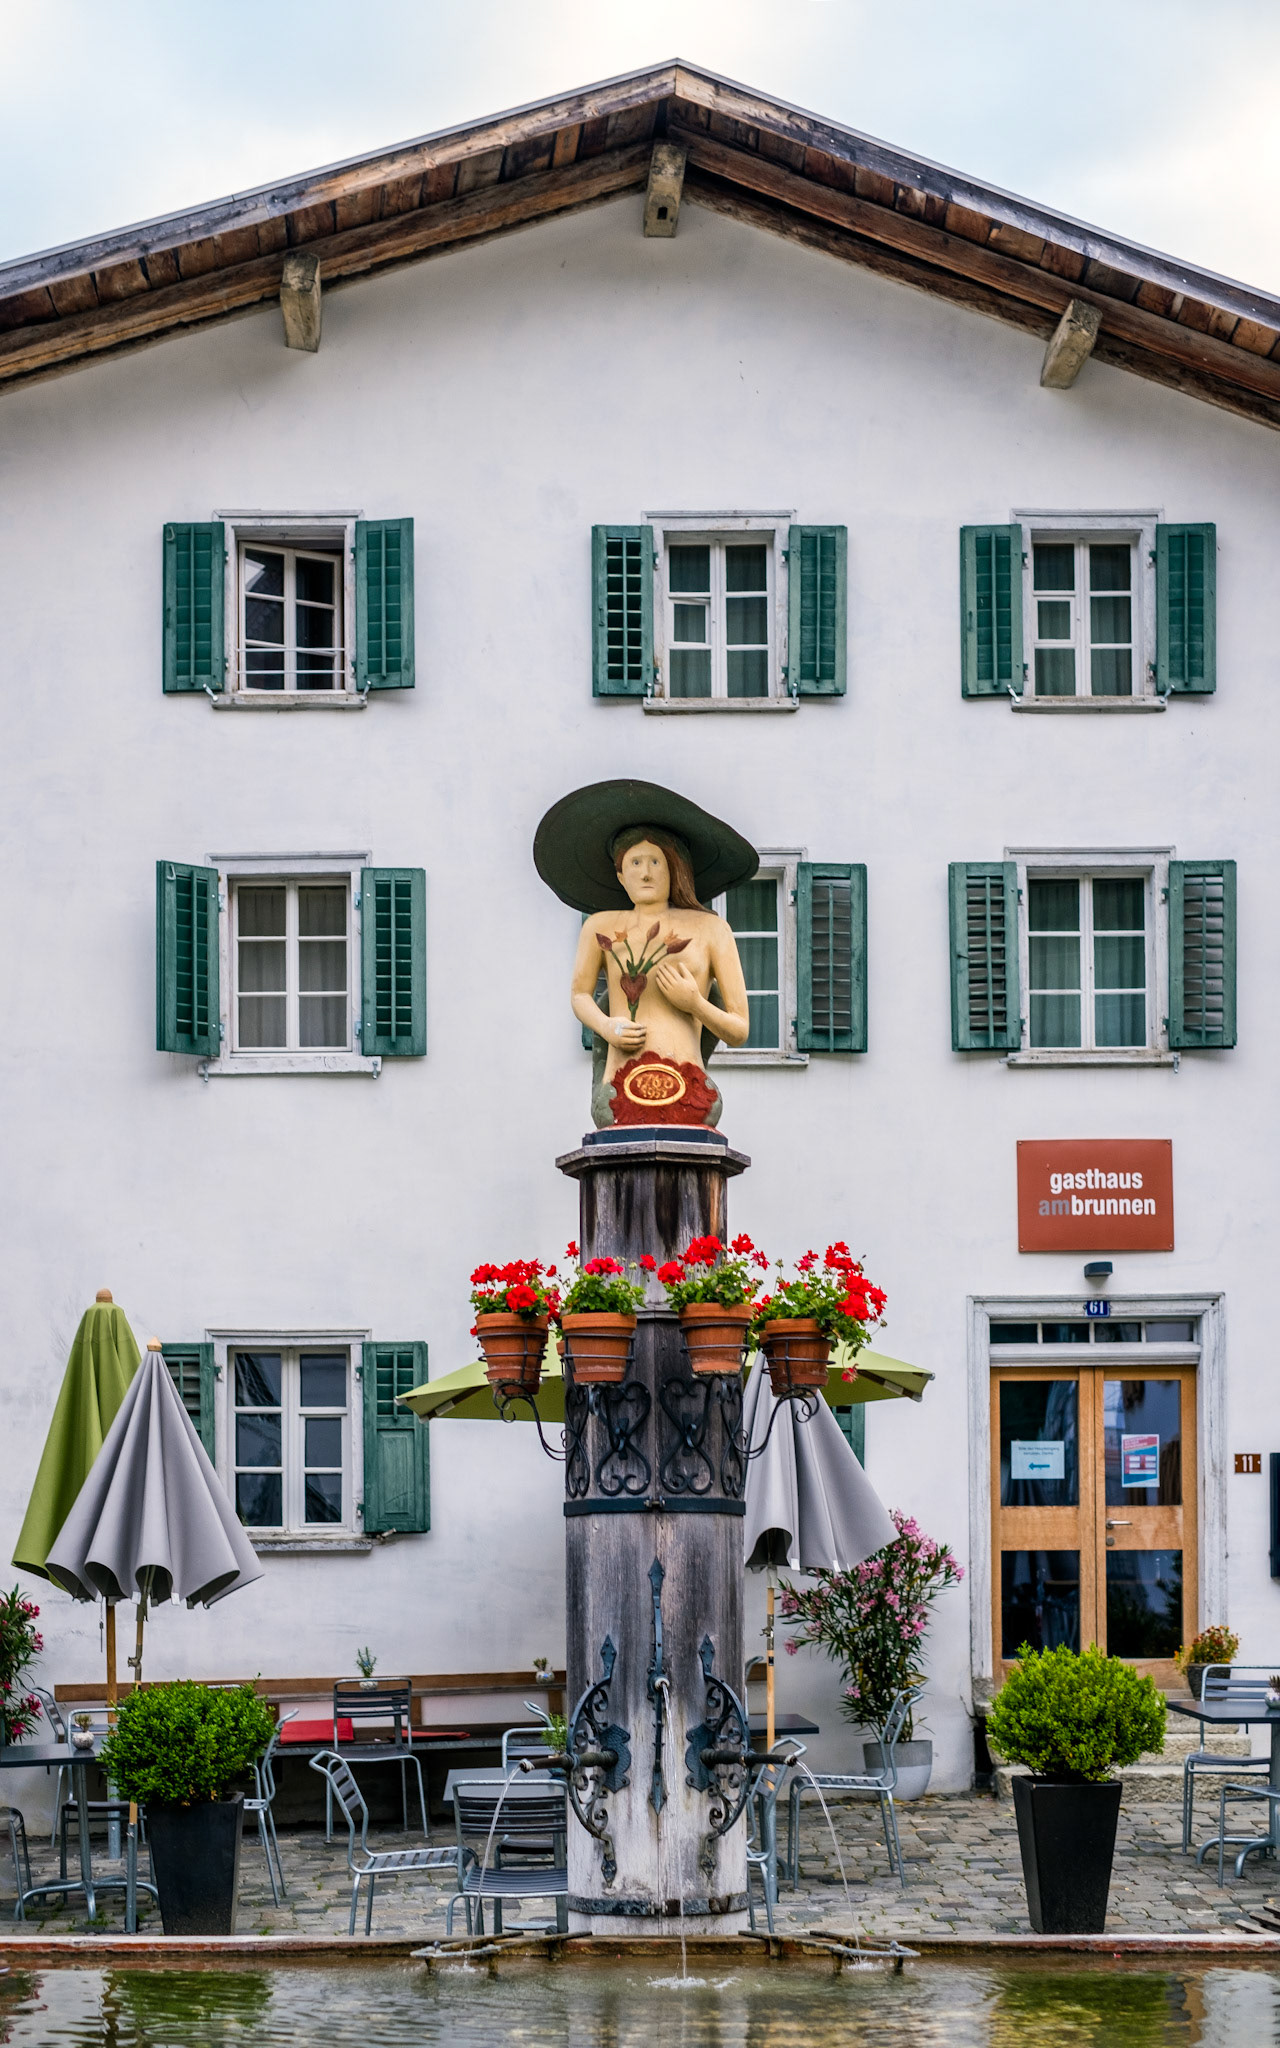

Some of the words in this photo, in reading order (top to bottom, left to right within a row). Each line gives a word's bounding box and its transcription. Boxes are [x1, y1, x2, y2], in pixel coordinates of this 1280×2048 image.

[1050, 1168, 1143, 1194] gasthaus
[1089, 1300, 1104, 1314] 61
[1242, 1455, 1253, 1472] 11
